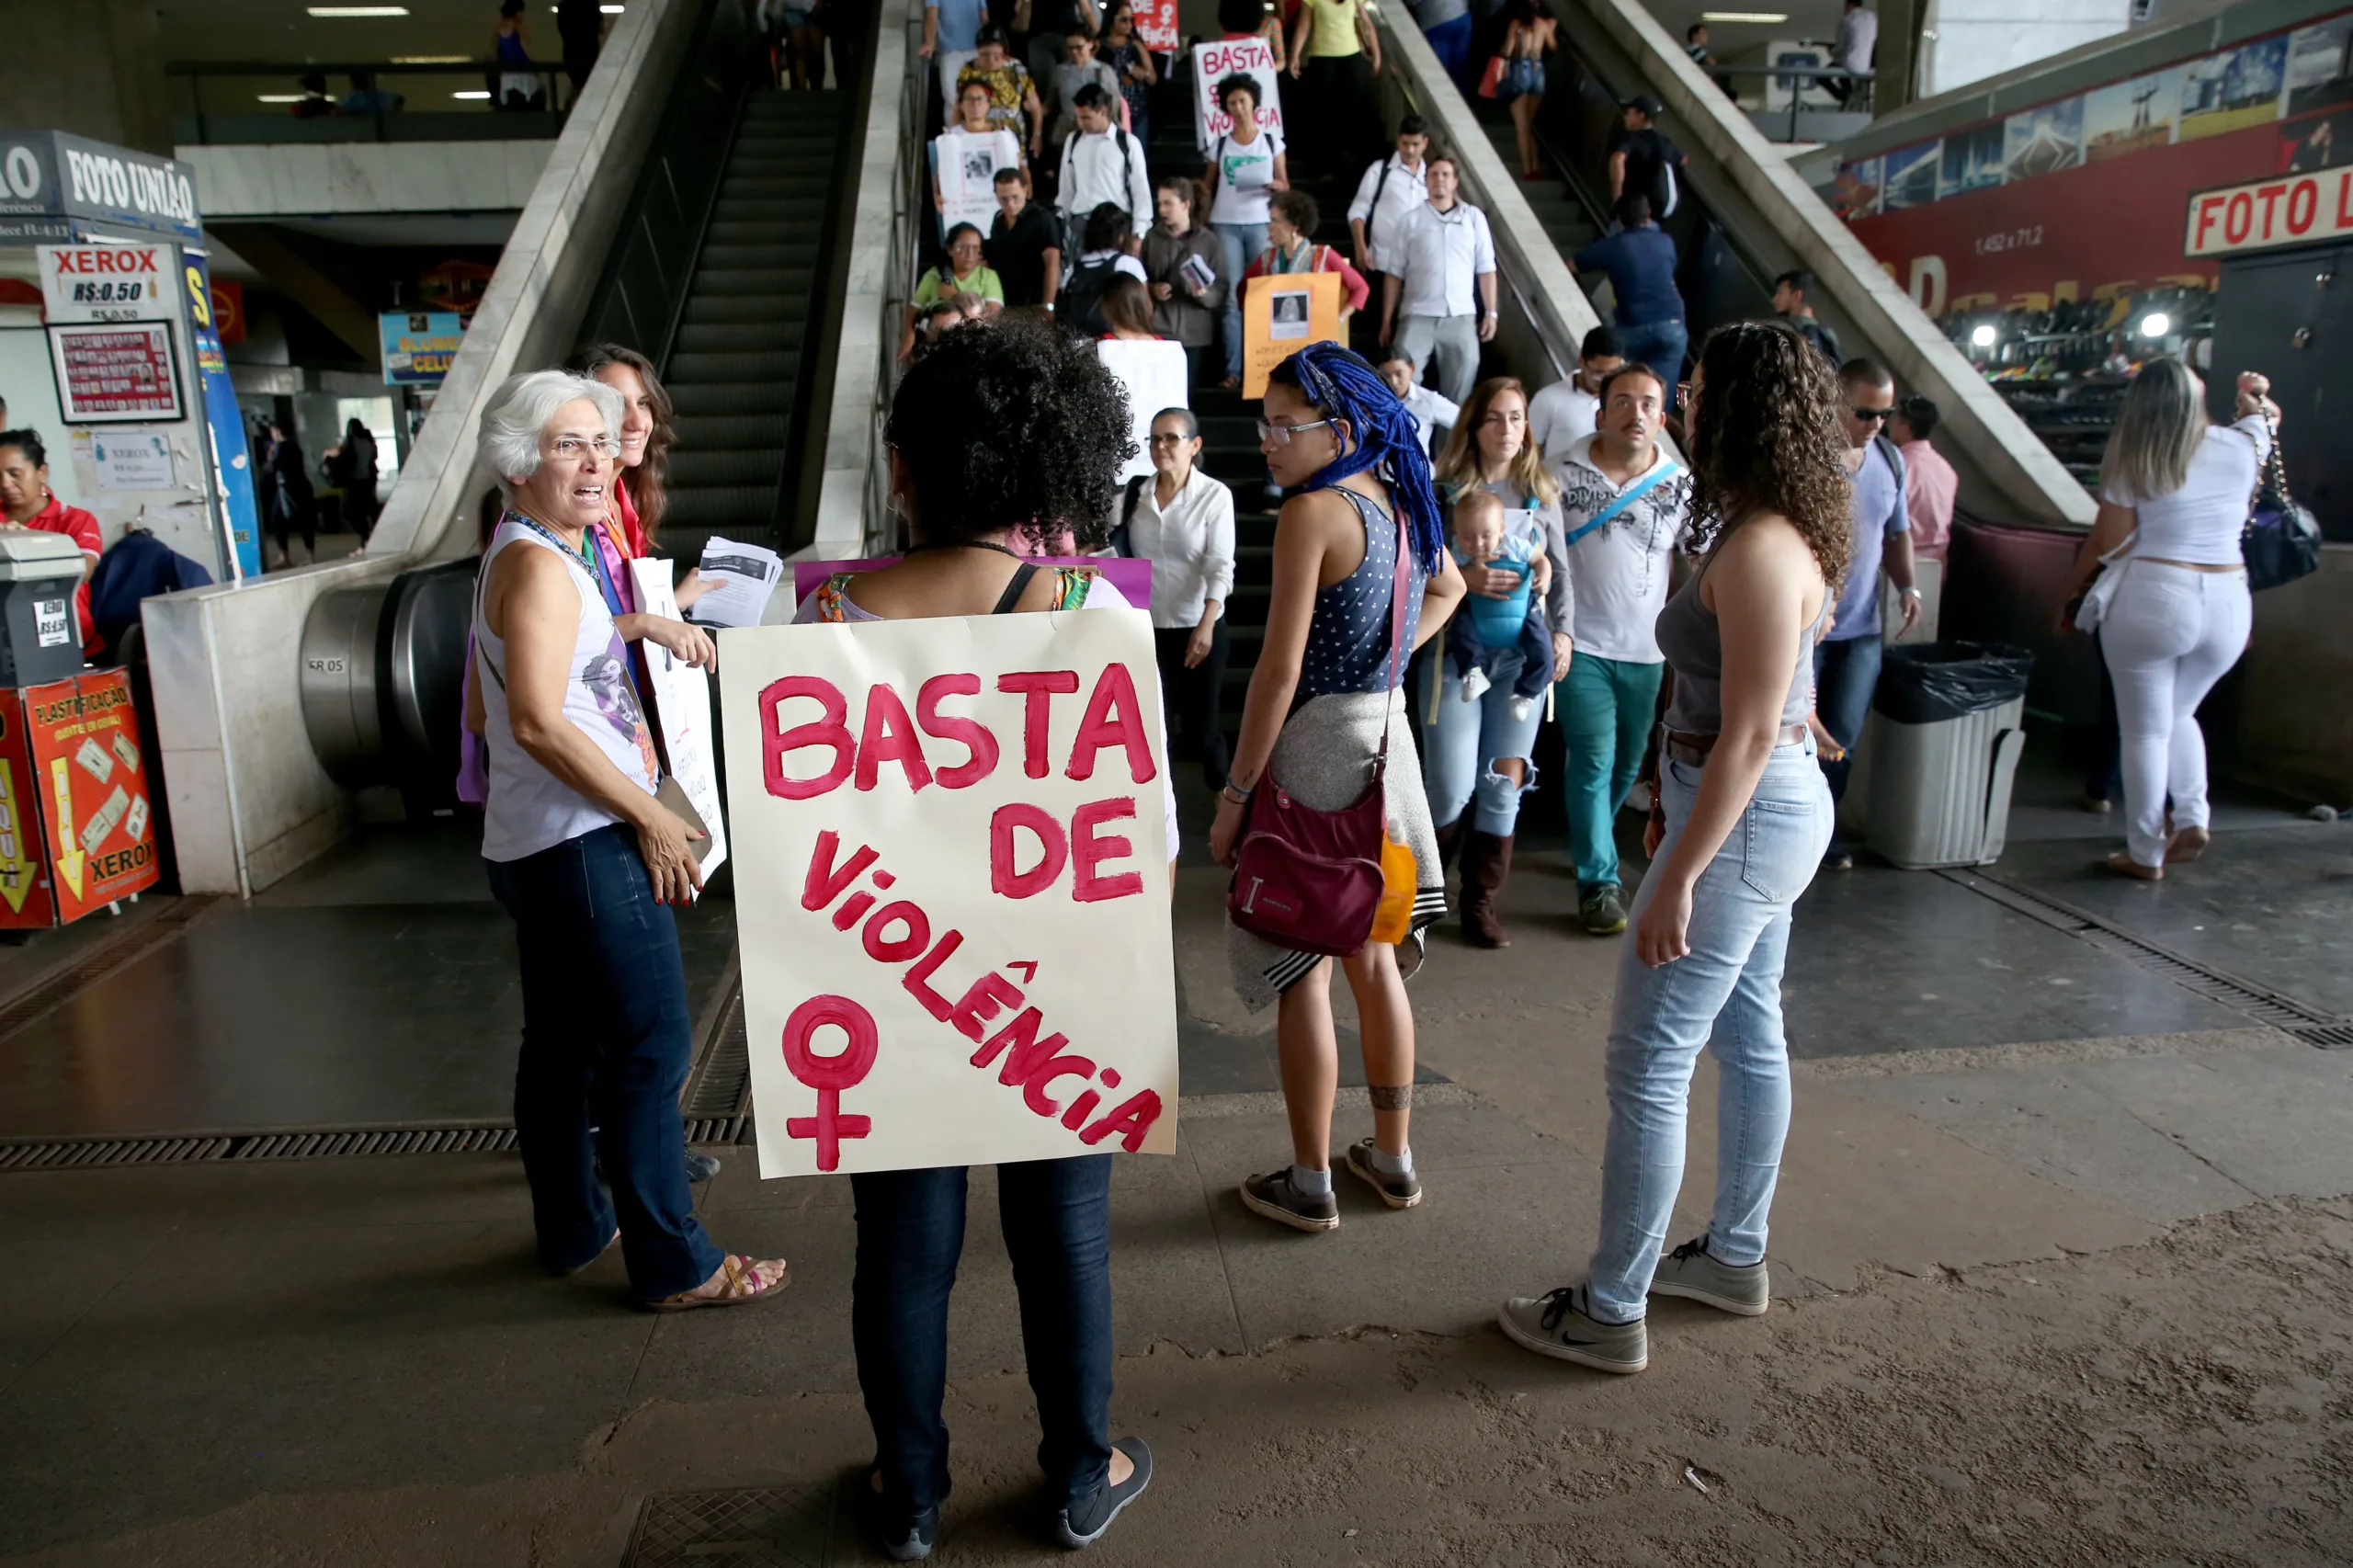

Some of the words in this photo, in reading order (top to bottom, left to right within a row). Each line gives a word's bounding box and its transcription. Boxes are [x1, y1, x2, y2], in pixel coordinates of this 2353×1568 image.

[1203, 46, 1273, 75] BASTA
[66, 149, 128, 209] FOTO
[127, 162, 193, 222] UNIÃO
[2195, 178, 2318, 251] FOTO
[55, 250, 158, 273] XEROX
[327, 660, 343, 672] 05
[759, 663, 1156, 801] BASTA
[90, 840, 153, 883] XEROX
[990, 797, 1143, 903] DE
